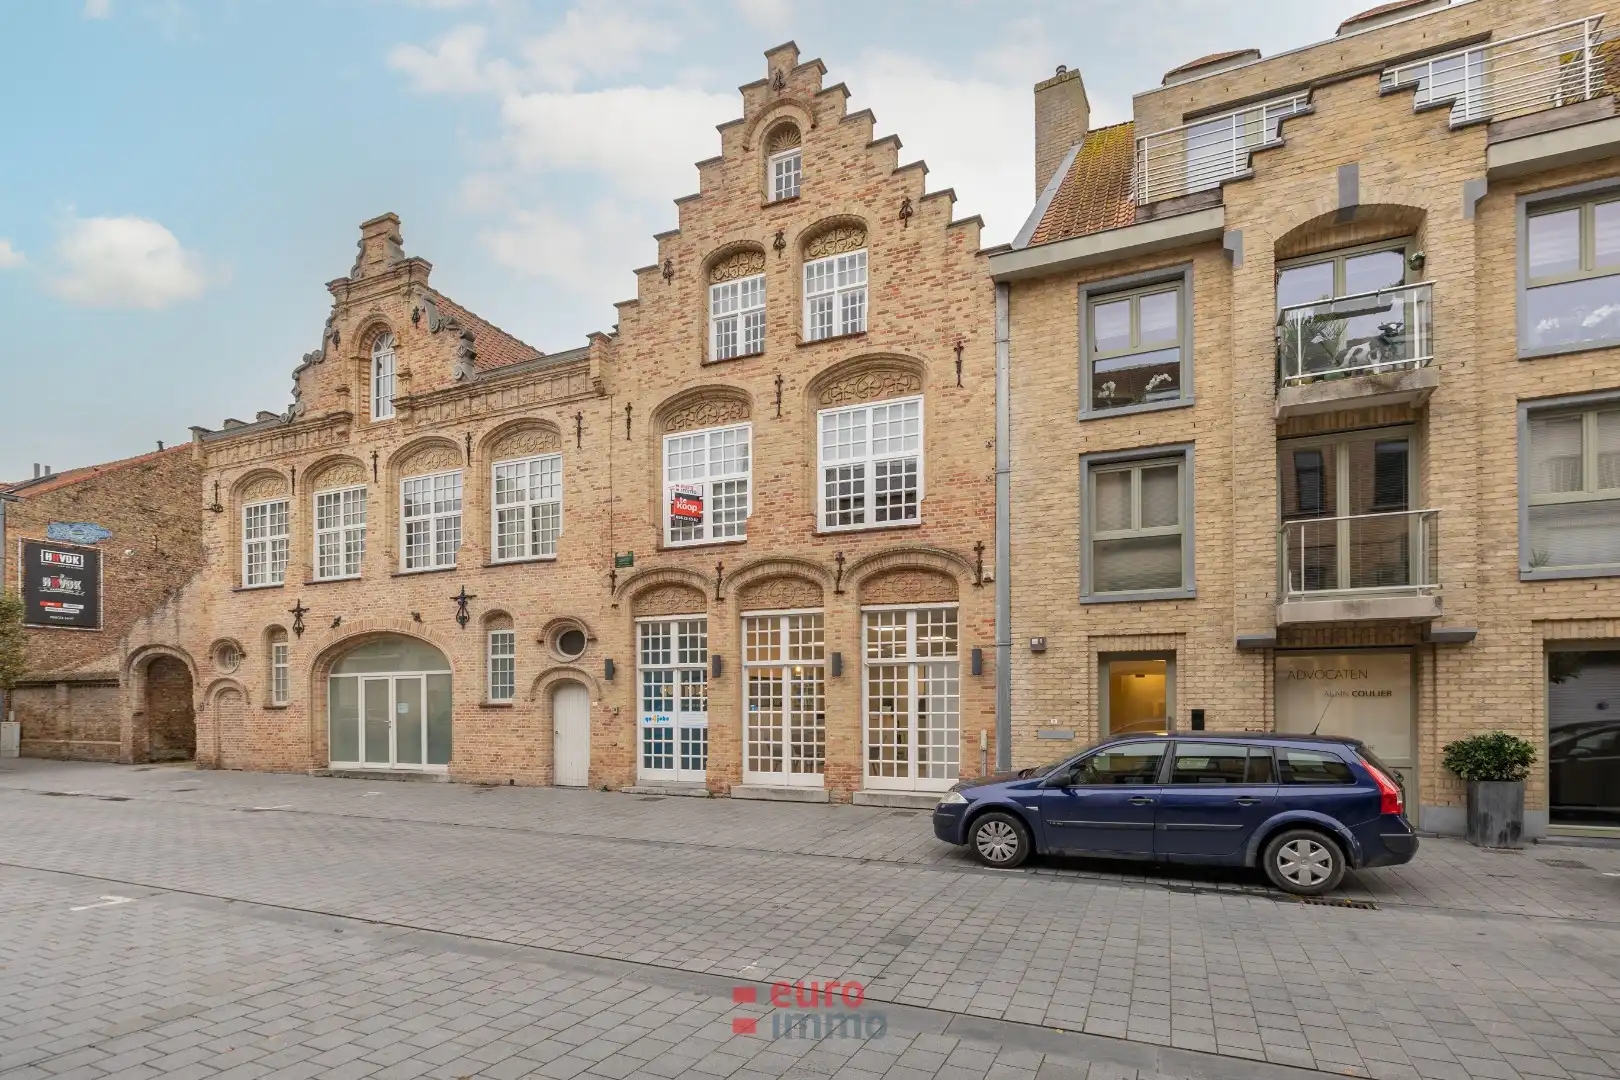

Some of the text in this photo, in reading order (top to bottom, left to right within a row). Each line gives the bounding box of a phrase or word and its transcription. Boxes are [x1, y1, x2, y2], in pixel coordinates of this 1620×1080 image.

[676, 501, 698, 513] koop
[1287, 669, 1368, 680] ADVOCATEN
[1324, 690, 1393, 698] ALAIN COULIER
